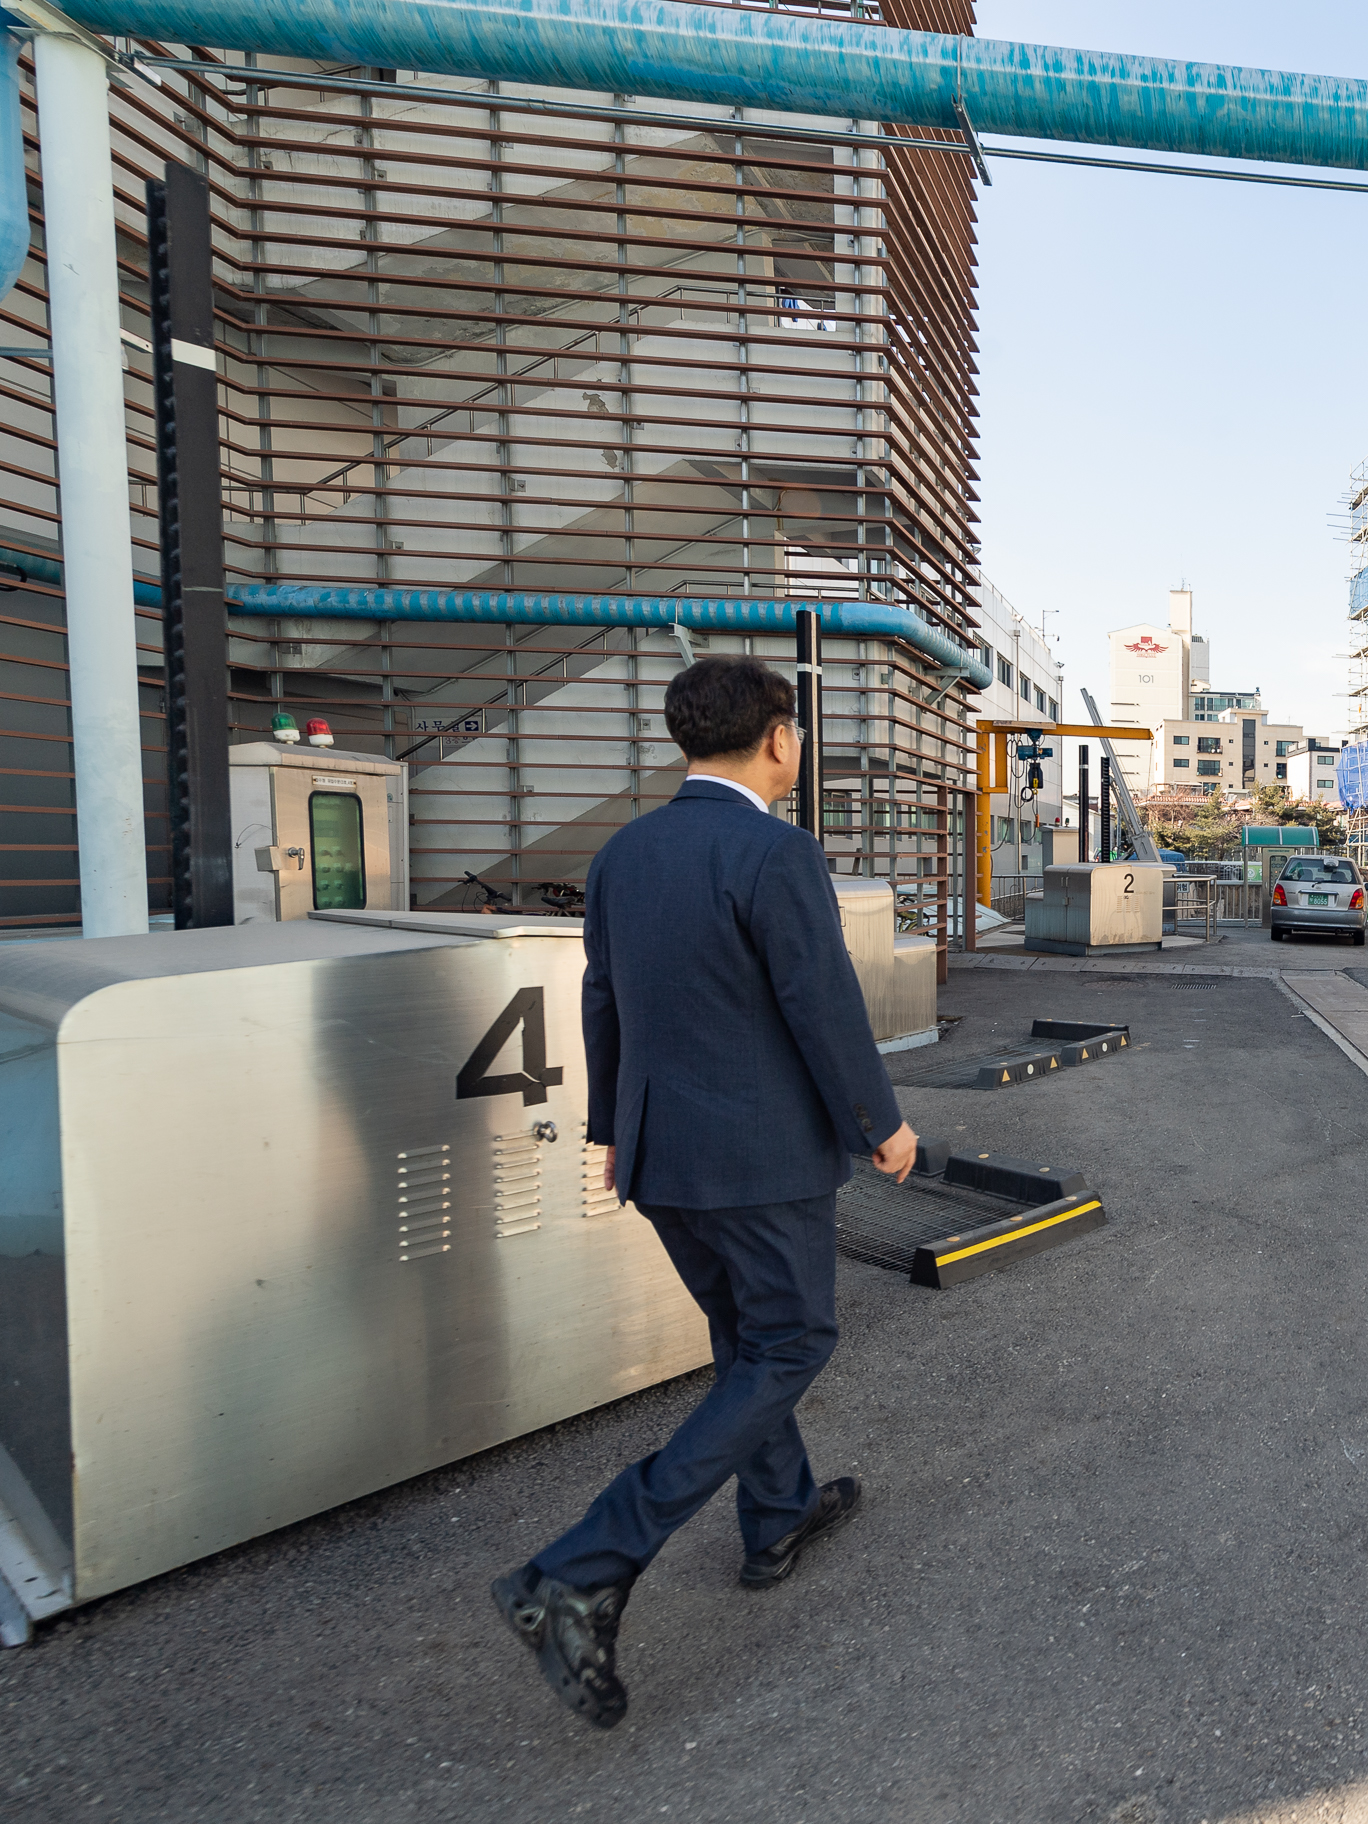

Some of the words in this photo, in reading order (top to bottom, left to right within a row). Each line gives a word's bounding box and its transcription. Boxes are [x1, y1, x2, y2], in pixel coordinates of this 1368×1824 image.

[1138, 674, 1154, 684] 101
[1123, 873, 1135, 893] 2
[455, 986, 564, 1107] 4
